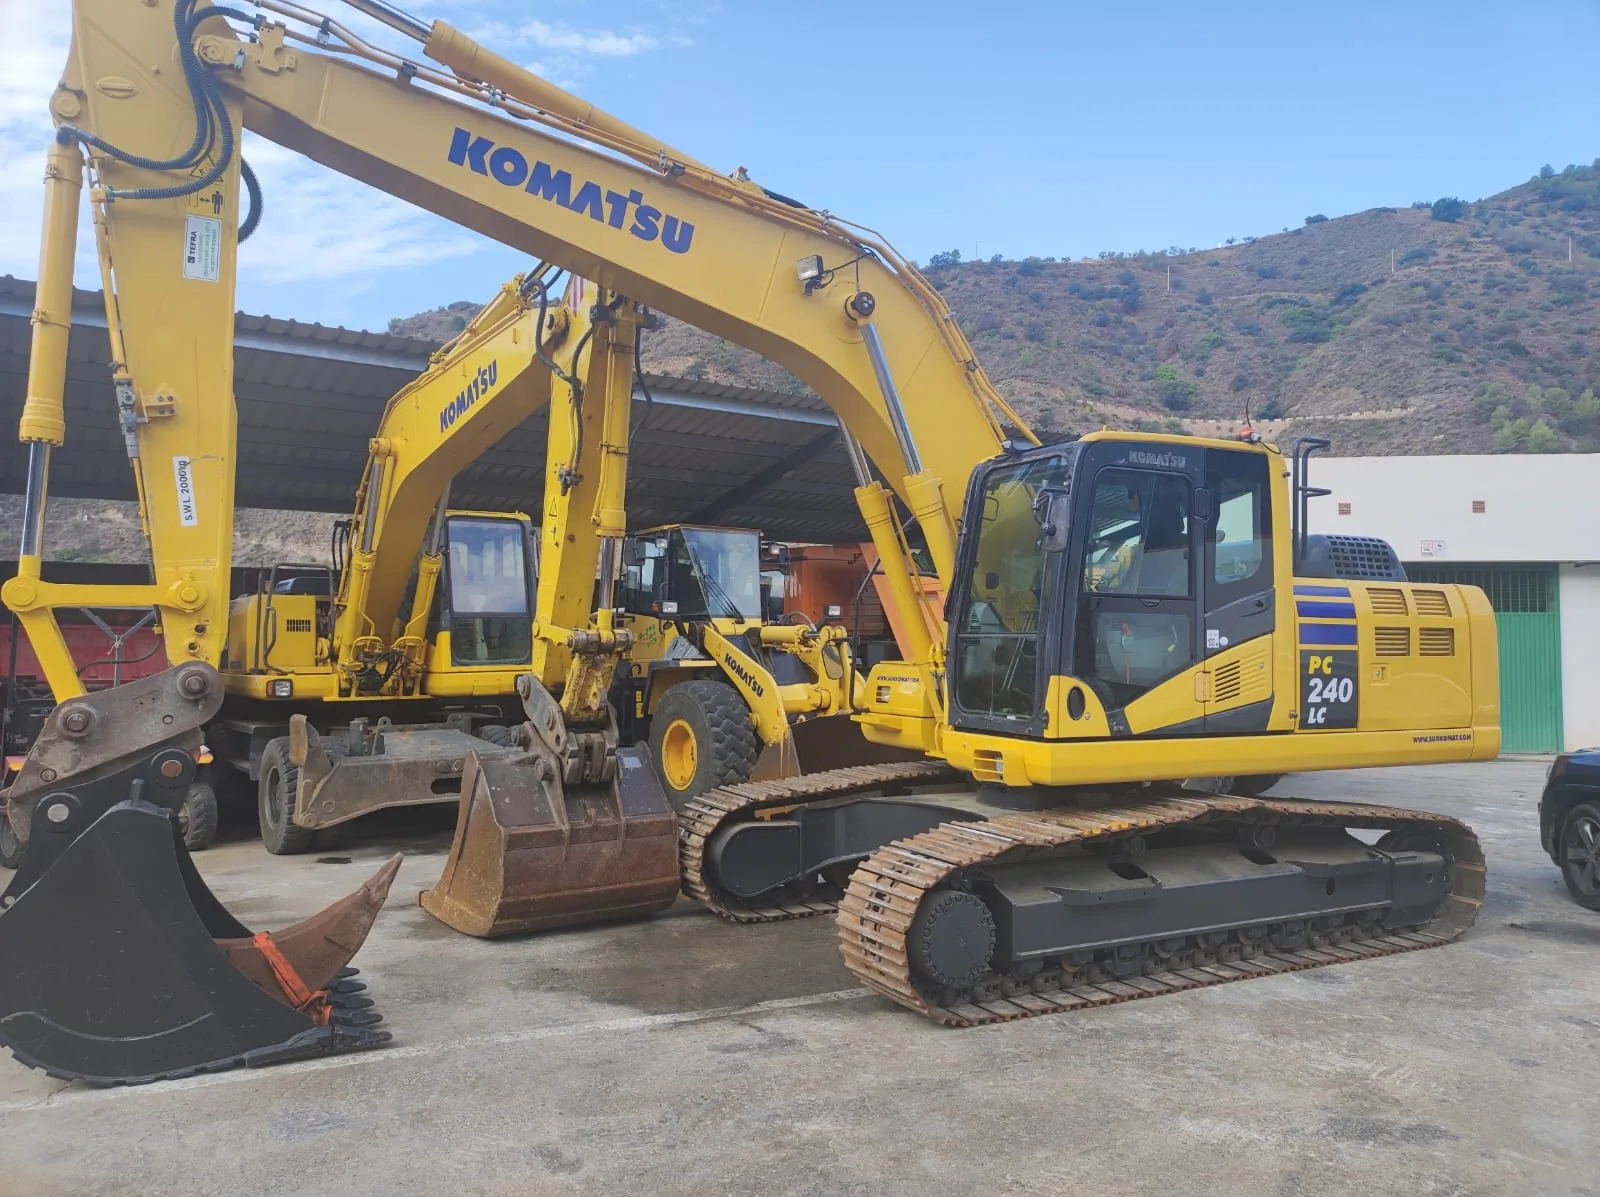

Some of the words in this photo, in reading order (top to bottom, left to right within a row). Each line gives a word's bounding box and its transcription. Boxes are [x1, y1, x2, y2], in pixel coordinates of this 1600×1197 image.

[448, 127, 695, 254] KOMATSU
[189, 231, 197, 255] TEFRA
[440, 359, 497, 433] KOMATSU
[1129, 450, 1186, 468] KOMATSU
[724, 653, 764, 698] KOMATSU
[1308, 655, 1333, 675] PC
[1307, 677, 1353, 703] 240
[1307, 707, 1327, 724] LC
